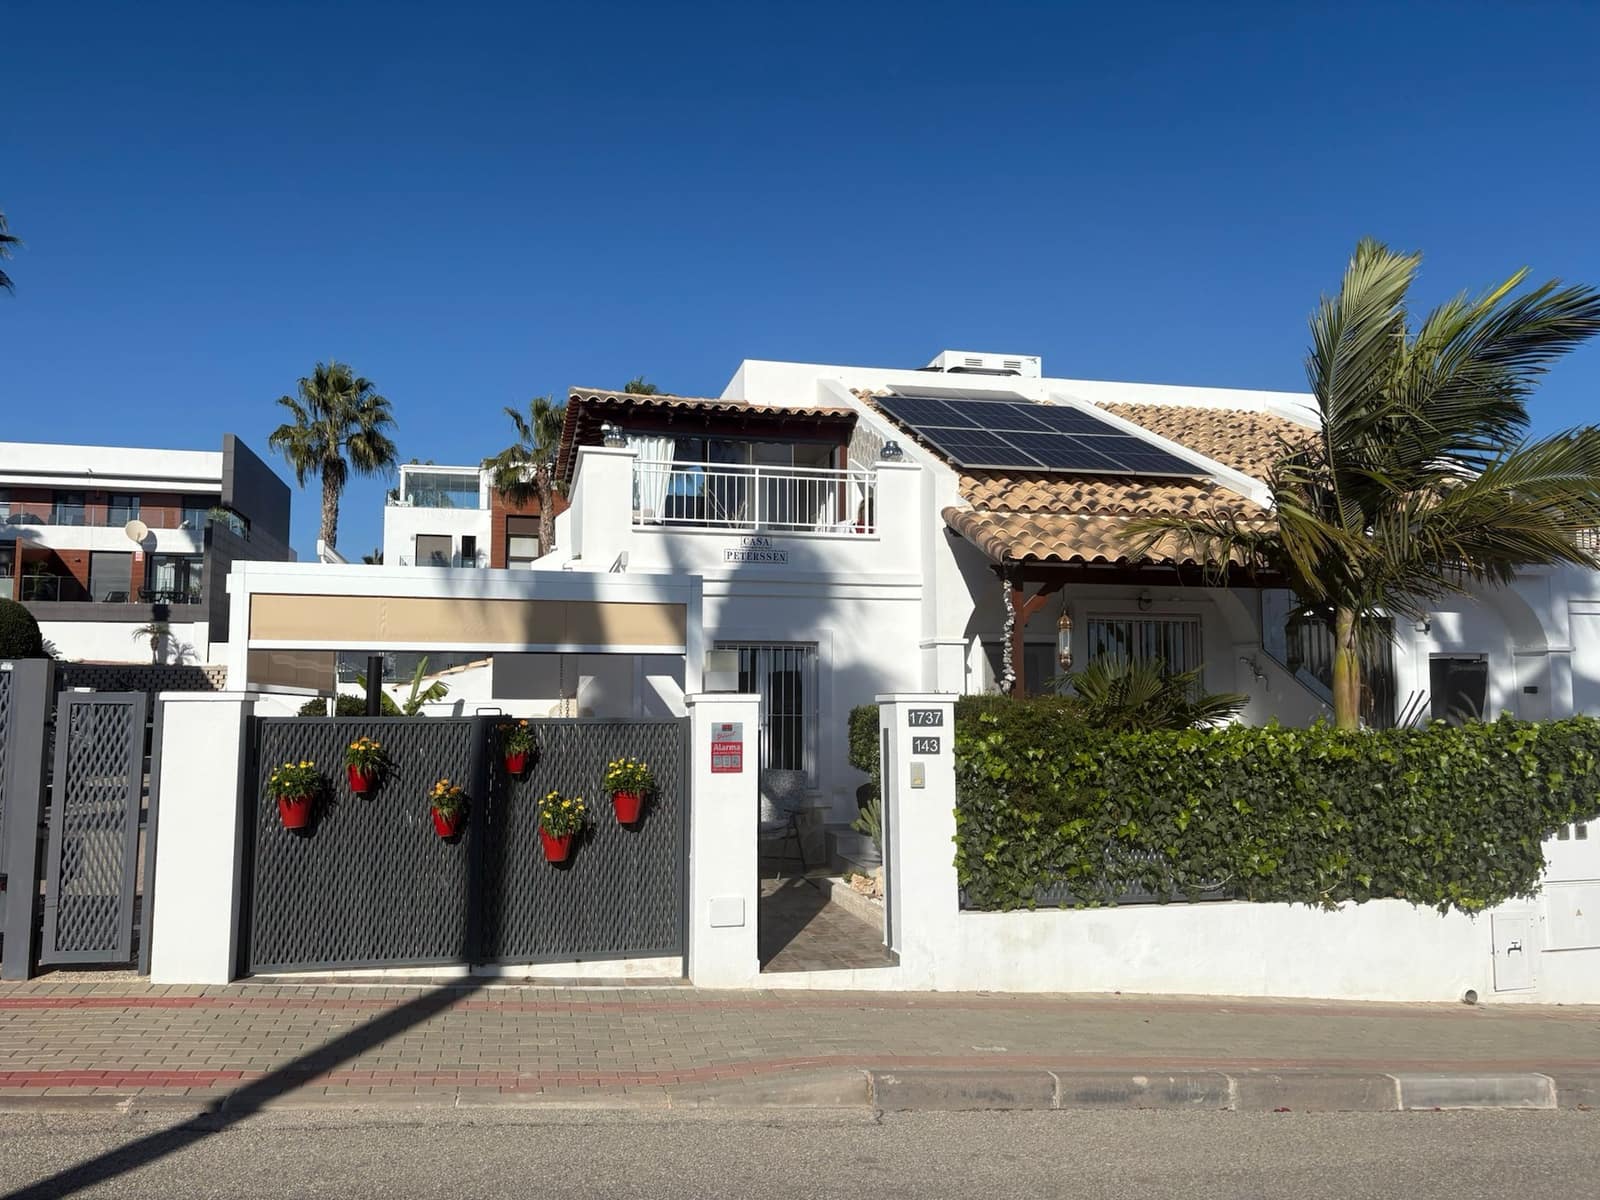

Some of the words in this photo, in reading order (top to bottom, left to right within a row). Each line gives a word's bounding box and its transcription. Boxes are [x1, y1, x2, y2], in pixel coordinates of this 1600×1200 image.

[743, 537, 769, 546] CASA
[727, 551, 786, 561] PETERSSEN
[910, 711, 941, 724] 1737
[915, 739, 938, 752] 143
